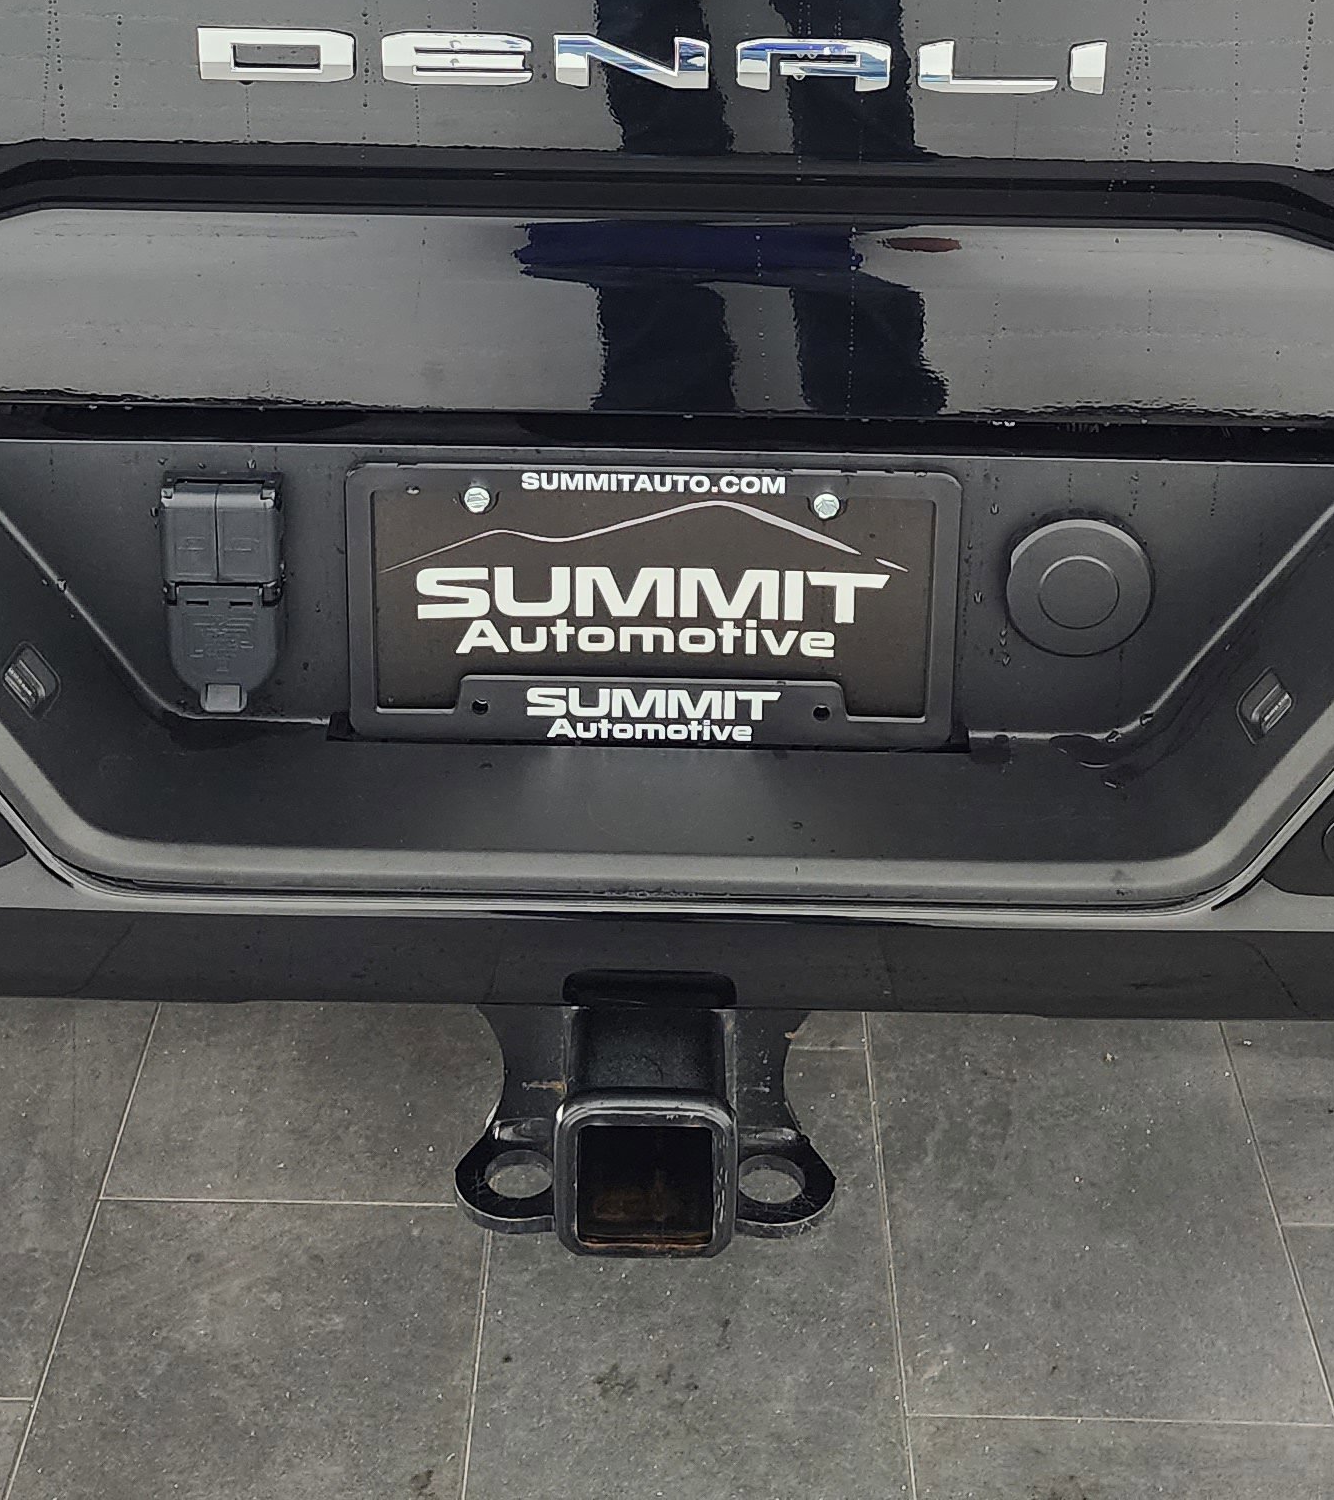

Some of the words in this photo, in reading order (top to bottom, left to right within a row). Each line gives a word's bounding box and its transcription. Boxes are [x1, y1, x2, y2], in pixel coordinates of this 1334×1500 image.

[197, 26, 1109, 97] DENALI
[520, 471, 787, 495] SUMMITAUTO.COM
[415, 566, 891, 624] SUMMIT
[455, 619, 835, 659] Automotive
[525, 687, 782, 721] SUMMIT
[546, 718, 754, 743] Automotive
